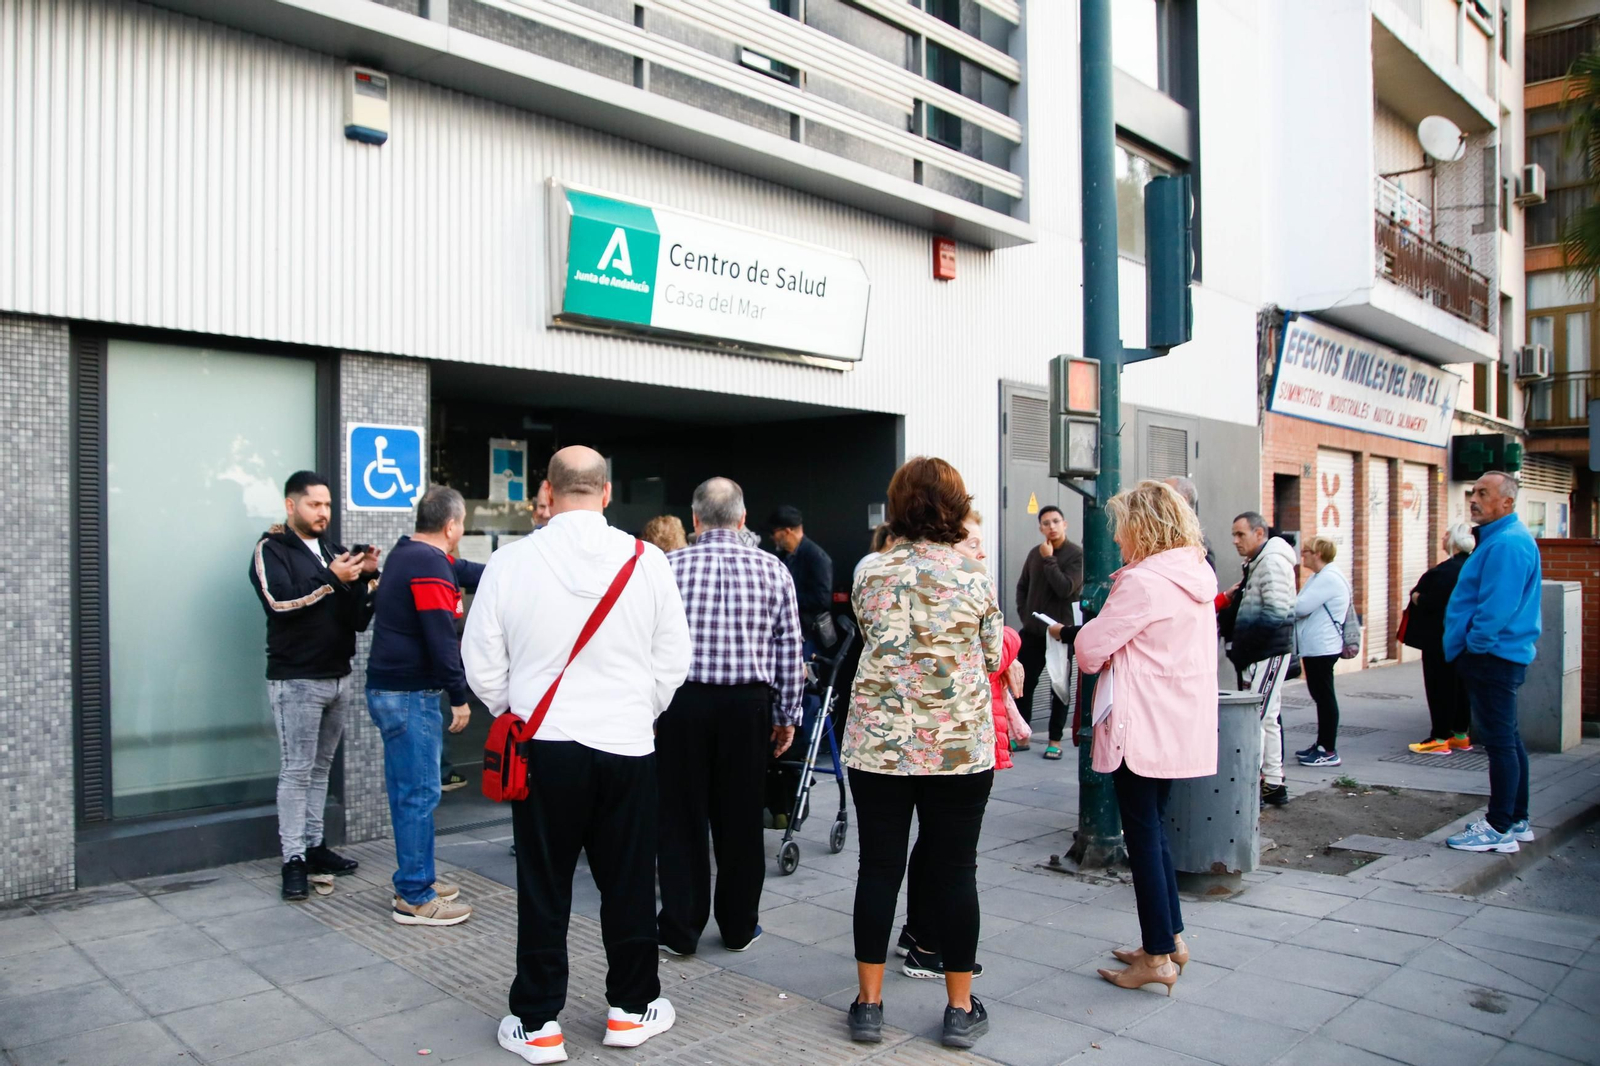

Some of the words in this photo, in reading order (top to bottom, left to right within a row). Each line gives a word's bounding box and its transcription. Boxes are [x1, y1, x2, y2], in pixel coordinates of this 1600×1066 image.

[573, 270, 598, 284] Junta
[598, 273, 610, 286] de
[609, 276, 650, 293] Andalucía
[669, 243, 740, 279] Centro
[747, 261, 770, 286] de
[775, 267, 827, 298] Salud
[664, 284, 703, 308] Casa
[708, 293, 733, 315] del
[740, 299, 766, 320] Mar
[1285, 329, 1343, 376] EFECTOS
[1342, 348, 1388, 391] NAVALES
[1386, 363, 1408, 397] DEL
[1406, 371, 1427, 402] SUR
[1278, 381, 1324, 408] SUMINISTROS
[1327, 394, 1371, 419] INDUSTRIALES
